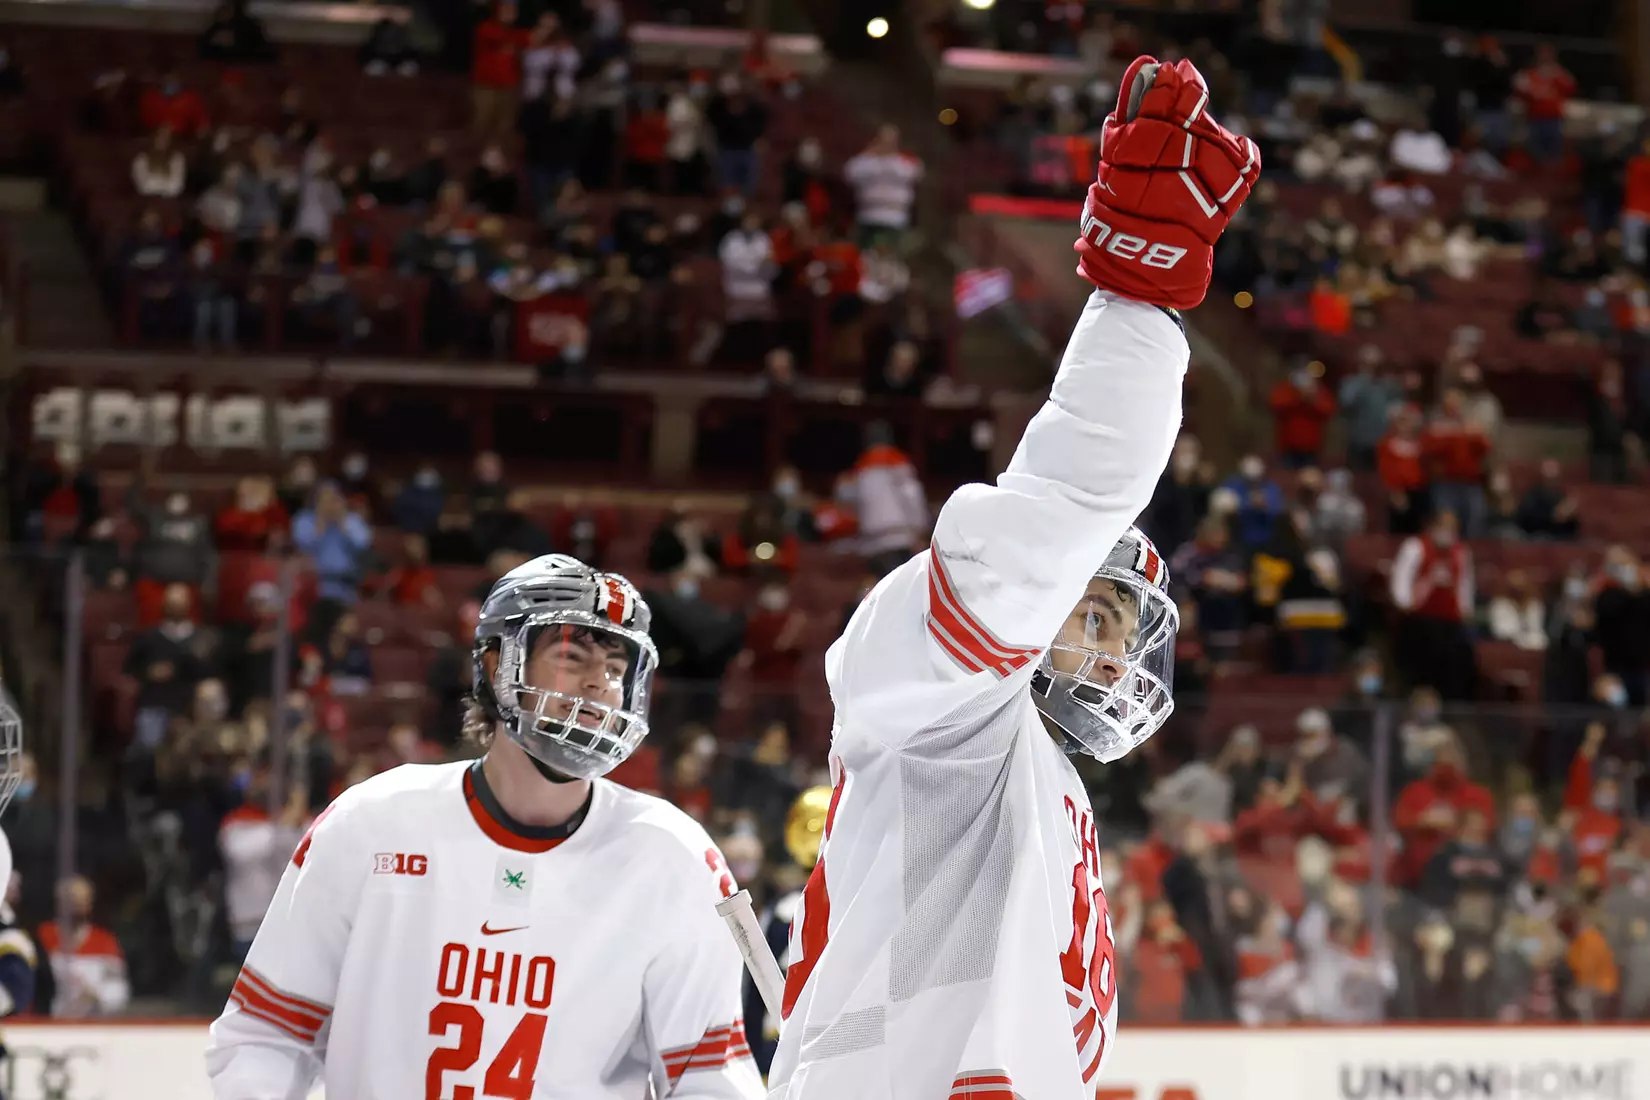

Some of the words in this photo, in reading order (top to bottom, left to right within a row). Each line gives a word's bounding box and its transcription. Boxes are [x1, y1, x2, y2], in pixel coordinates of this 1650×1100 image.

[436, 942, 556, 1010] OHIO
[425, 1001, 549, 1100] 24
[1338, 1060, 1500, 1100] UNION
